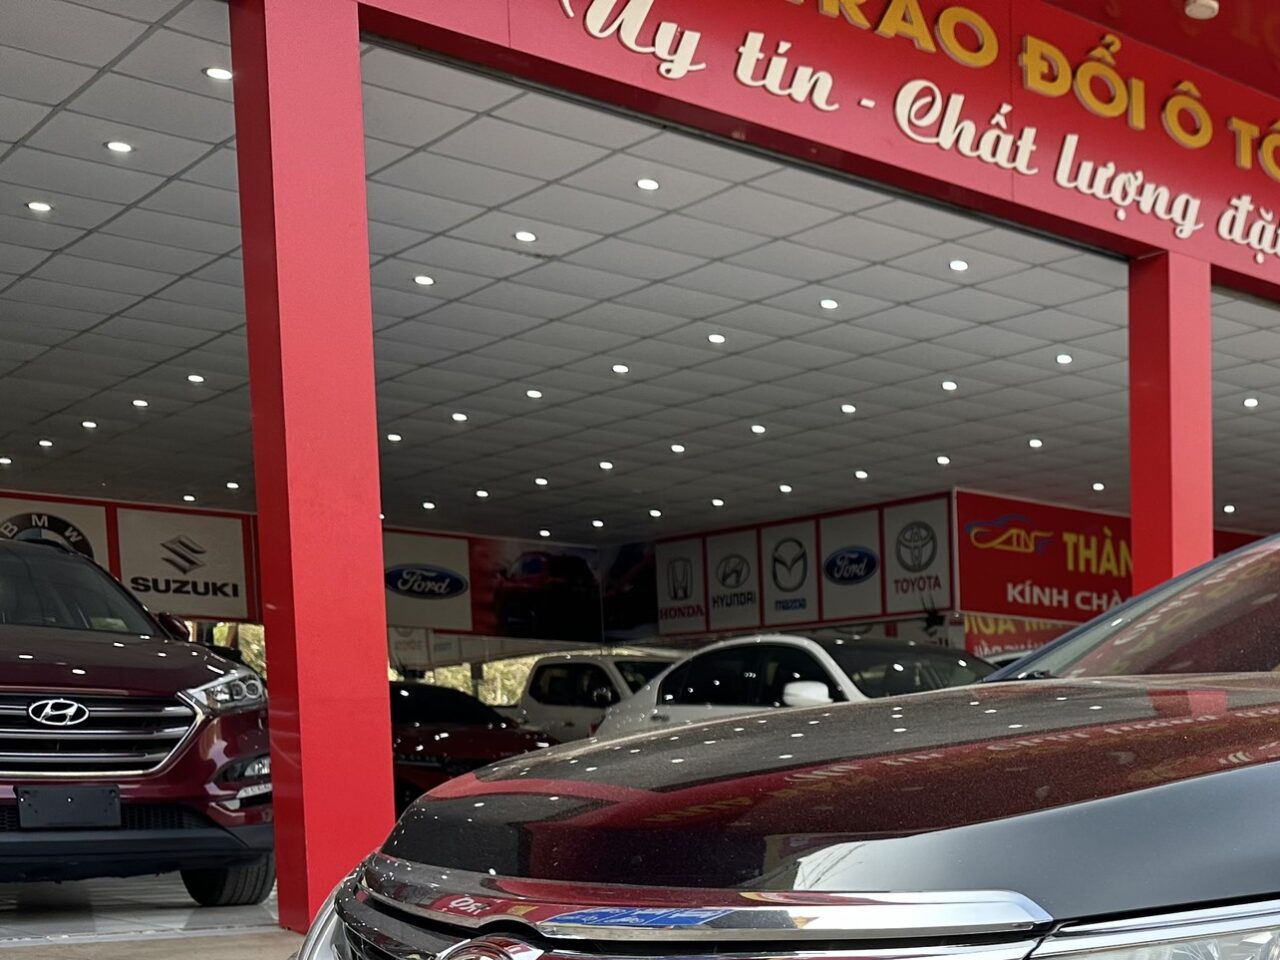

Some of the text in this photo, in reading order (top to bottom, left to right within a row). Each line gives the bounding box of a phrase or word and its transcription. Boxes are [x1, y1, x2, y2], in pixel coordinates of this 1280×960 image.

[1018, 33, 1145, 130] ĐỔI
[1161, 80, 1214, 148] Ô
[734, 31, 840, 111] tín
[894, 79, 1039, 175] Chất
[1054, 134, 1204, 239] lượng
[833, 554, 869, 578] Ford
[130, 575, 239, 598] SUZUKI
[397, 568, 451, 595] Ford
[894, 575, 941, 594] TOYOTA
[712, 591, 756, 608] HYUNDAI
[1006, 580, 1128, 611] KÍNH CHÀ
[660, 605, 704, 619] HONDA
